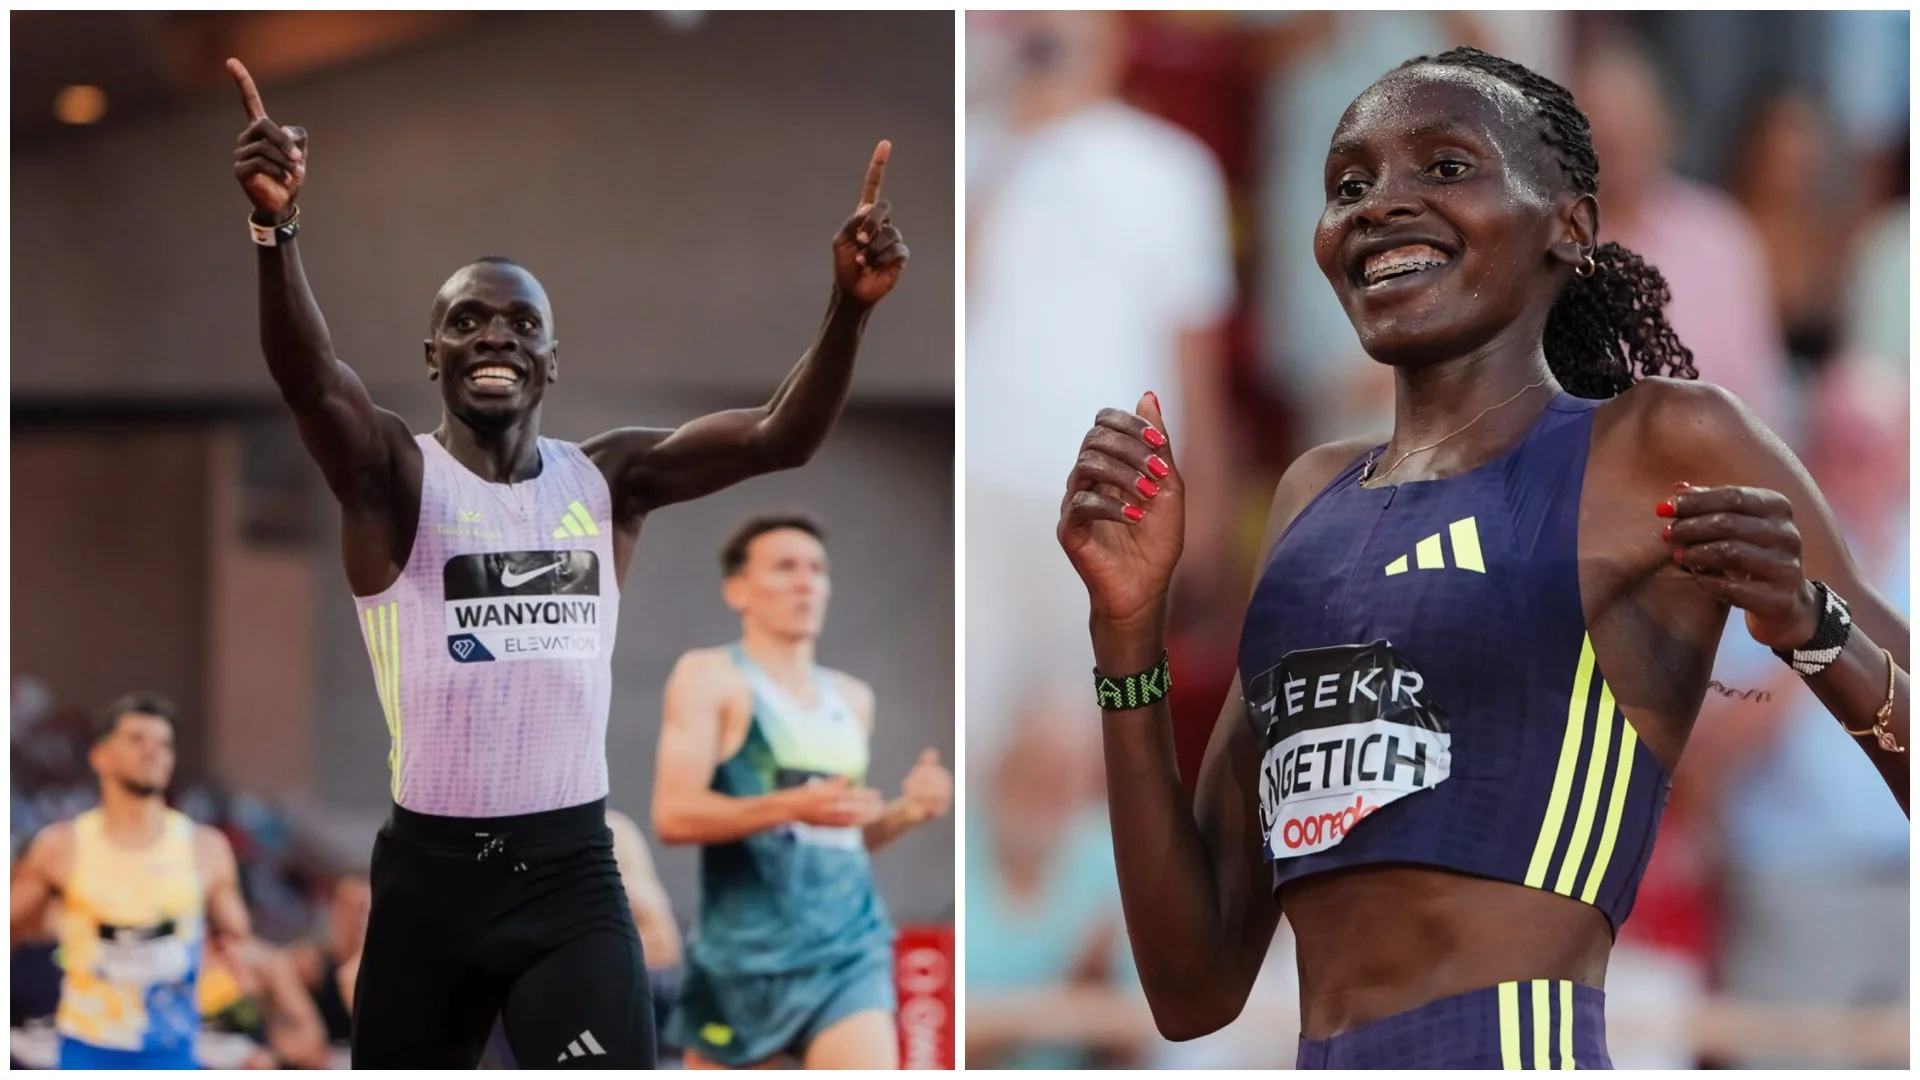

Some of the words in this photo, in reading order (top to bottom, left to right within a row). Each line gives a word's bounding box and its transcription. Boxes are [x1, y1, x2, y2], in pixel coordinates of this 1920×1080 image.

[455, 602, 596, 628] WANYONYI
[504, 636, 596, 652] ELEVATION
[1264, 733, 1427, 814] NGETICH
[1283, 795, 1381, 849] oored
